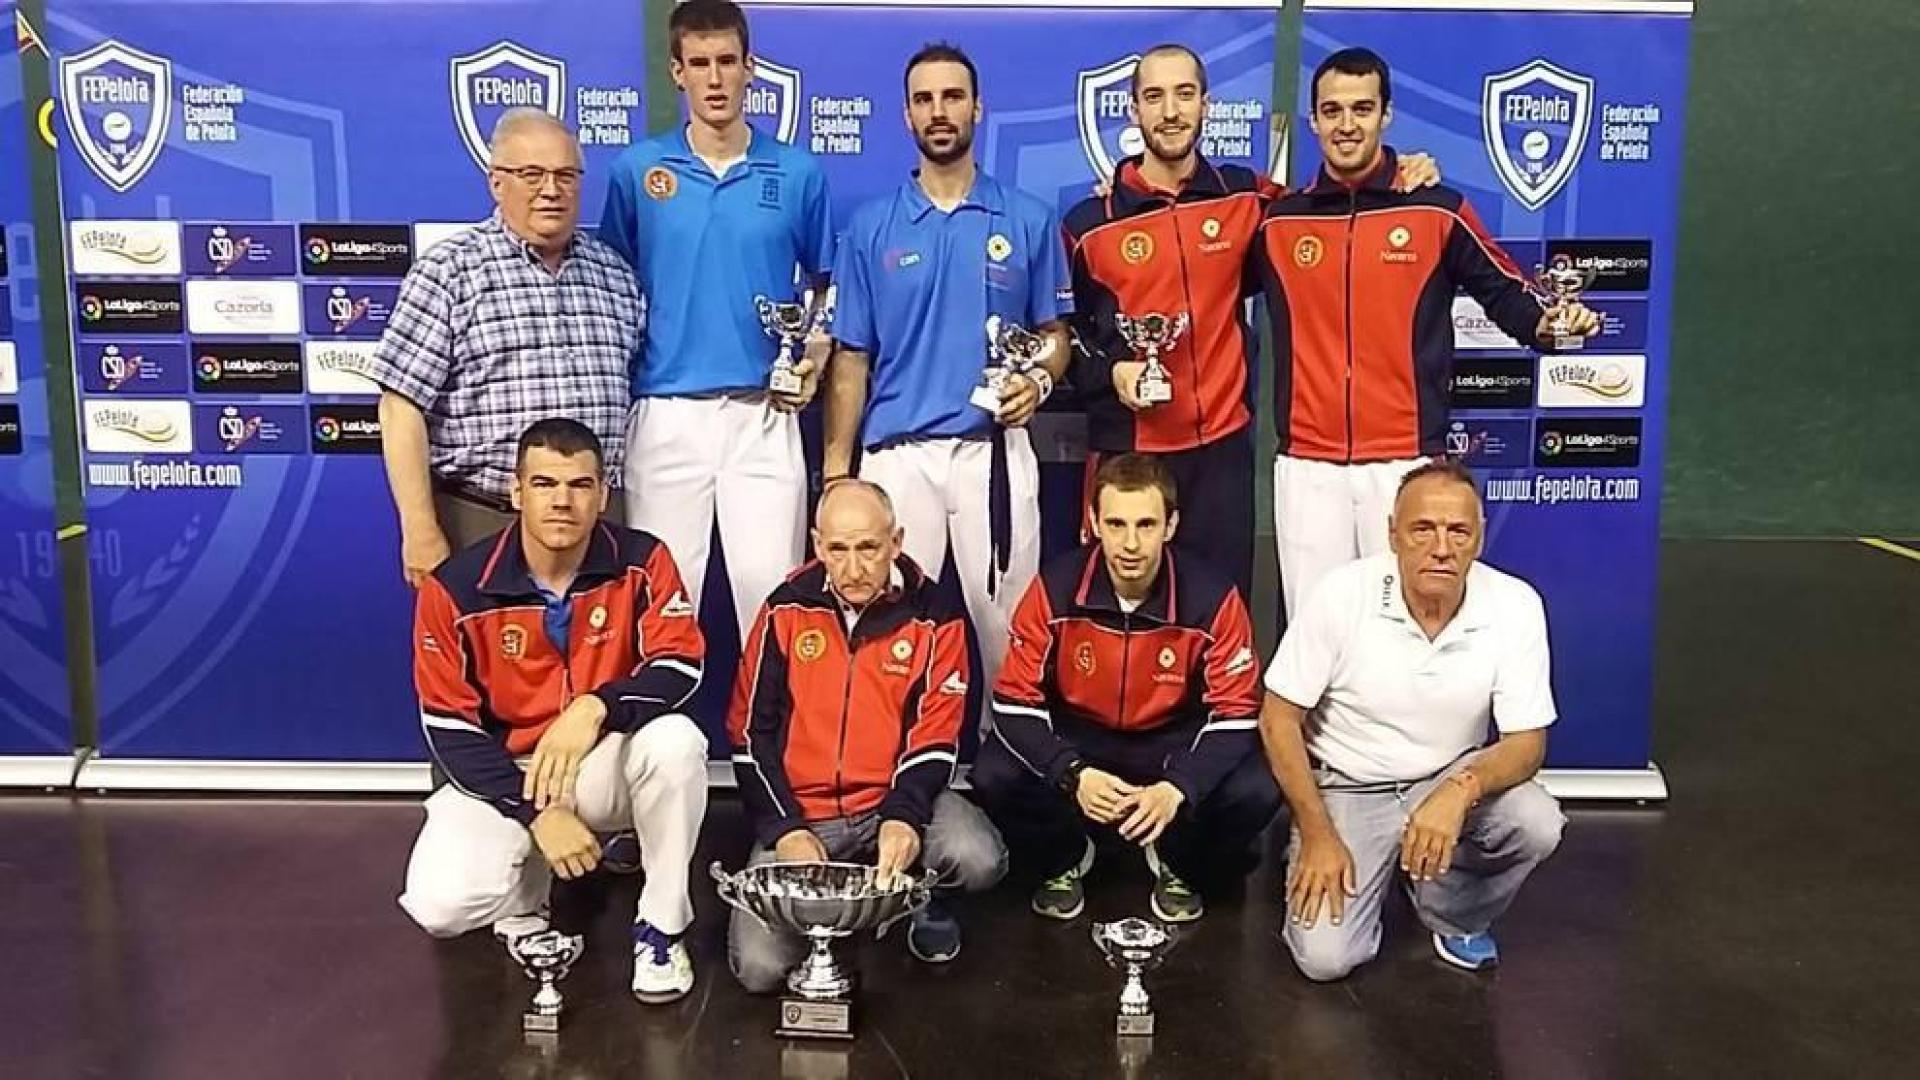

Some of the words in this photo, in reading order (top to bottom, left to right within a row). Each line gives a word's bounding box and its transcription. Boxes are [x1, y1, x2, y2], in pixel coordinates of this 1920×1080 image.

[82, 75, 149, 103] FEPelota
[184, 84, 244, 104] Federación
[474, 77, 542, 105] FEPelota
[577, 87, 639, 107] Federación
[743, 88, 777, 115] lota
[811, 96, 871, 115] Federación
[1207, 99, 1263, 119] ederación
[1505, 94, 1569, 122] FEPelota
[186, 105, 234, 123] Española
[578, 107, 628, 125] Española
[1603, 103, 1660, 123] Federación
[186, 125, 200, 141] de
[202, 124, 237, 141] Pelota
[811, 116, 860, 134] Española
[1203, 119, 1251, 138] Española
[1602, 123, 1649, 141] Española
[579, 126, 593, 145] de
[595, 126, 630, 145] Pelota
[811, 135, 826, 153] de
[828, 135, 862, 153] Pelota
[1202, 138, 1215, 157] de
[1217, 138, 1251, 157] Pelota
[1601, 141, 1615, 160] de
[1616, 141, 1649, 160] Pelota
[103, 298, 180, 313] LaLiga4Sports
[214, 299, 273, 313] Cazorla
[223, 358, 299, 372] LaLiga4Sports
[1455, 374, 1531, 389] LaLiga4Sports
[1565, 434, 1639, 447] LaLiga4Sports
[88, 459, 242, 490] www.fepelota.com
[1486, 474, 1639, 504] www.fepelota.com
